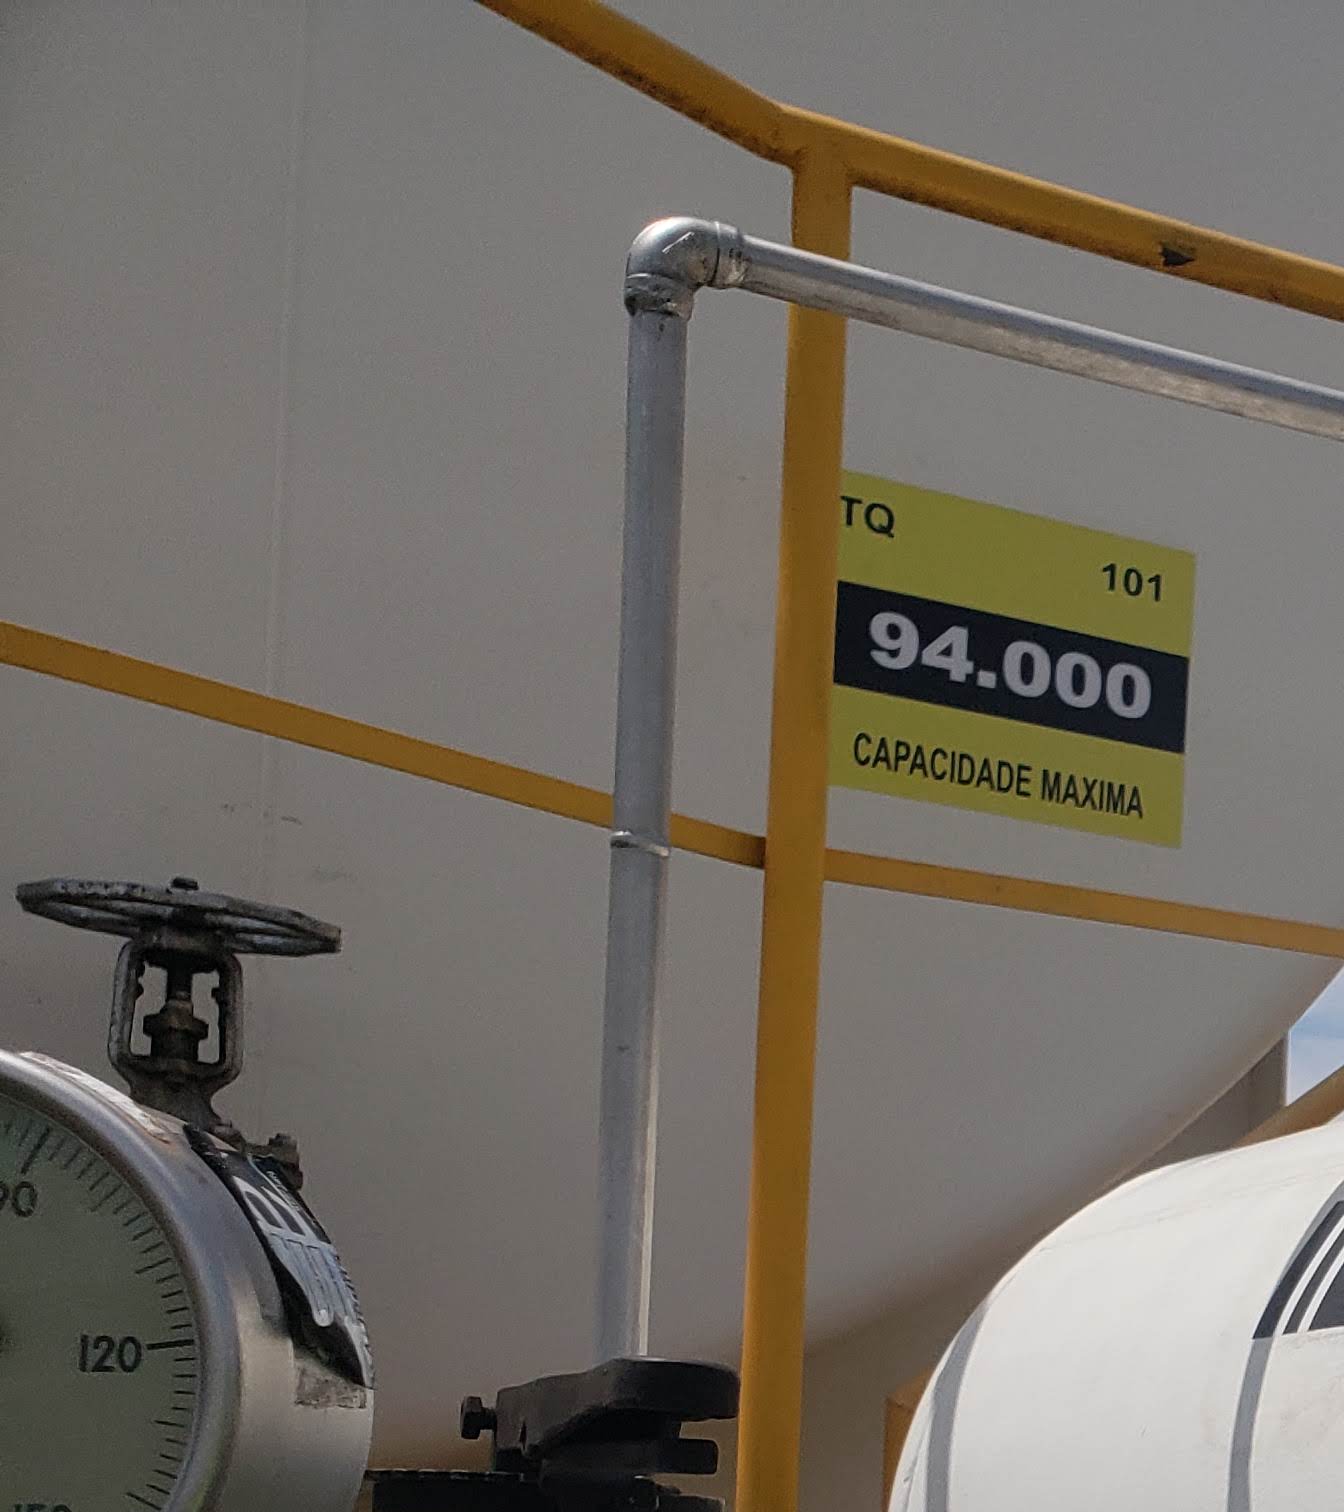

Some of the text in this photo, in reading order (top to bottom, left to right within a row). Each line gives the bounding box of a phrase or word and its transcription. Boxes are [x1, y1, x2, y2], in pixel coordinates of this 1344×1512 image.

[840, 495, 1162, 602] TQ 101
[869, 611, 1152, 719] 94.000
[853, 733, 1144, 819] CAPACIDADE MAXIMA
[78, 1333, 143, 1374] 120
